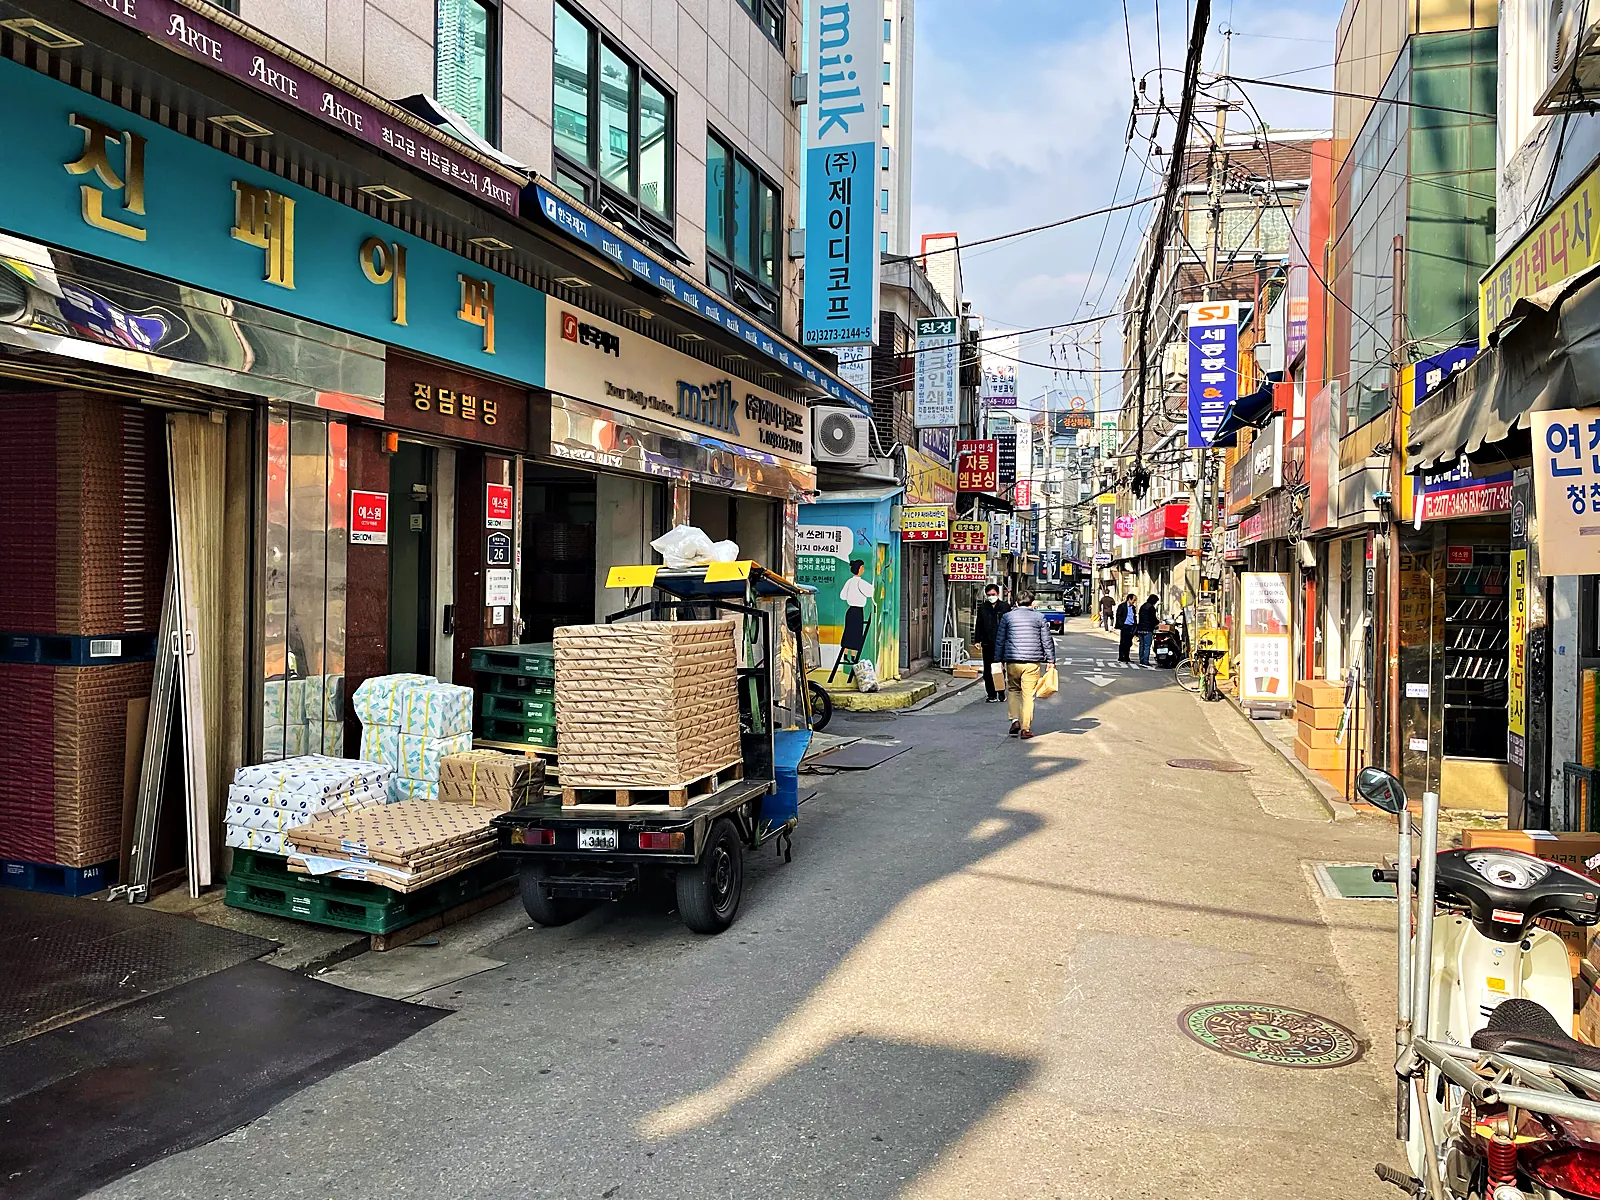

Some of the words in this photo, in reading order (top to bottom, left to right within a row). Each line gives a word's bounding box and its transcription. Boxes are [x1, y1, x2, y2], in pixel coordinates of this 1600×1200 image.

[166, 14, 223, 62] ARTE
[249, 56, 298, 99] ARTE
[818, 2, 865, 140] miilk
[319, 92, 363, 131] ARTE
[382, 127, 416, 157] 최고급
[420, 146, 478, 190] 러프글로스지
[481, 176, 512, 206] ARTE
[558, 207, 588, 238] 한국제지
[64, 113, 497, 354] 진페이퍼
[602, 239, 624, 262] miilk
[632, 257, 652, 279] miilk
[659, 274, 676, 295] miilk
[683, 291, 699, 309] miilk
[705, 305, 721, 322] miilk
[1198, 306, 1230, 321] SJ
[726, 317, 740, 334] miilk
[745, 330, 759, 346] miilk
[806, 327, 871, 342] 02)3273-2144~5
[413, 382, 498, 425] 정담빌딩
[676, 379, 741, 437] miilk
[966, 455, 990, 471] 자동
[959, 472, 995, 488] 엠보싱
[491, 496, 508, 509] 에스원
[358, 506, 382, 520] 에스원
[352, 533, 372, 541] SECOM
[806, 530, 842, 542] 쓰레기를
[953, 532, 985, 543] 명함
[494, 549, 504, 560] 26
[813, 545, 839, 553] 마세요!
[950, 563, 984, 573] 엠보싱전문
[1514, 559, 1525, 726] 태평카렌다사
